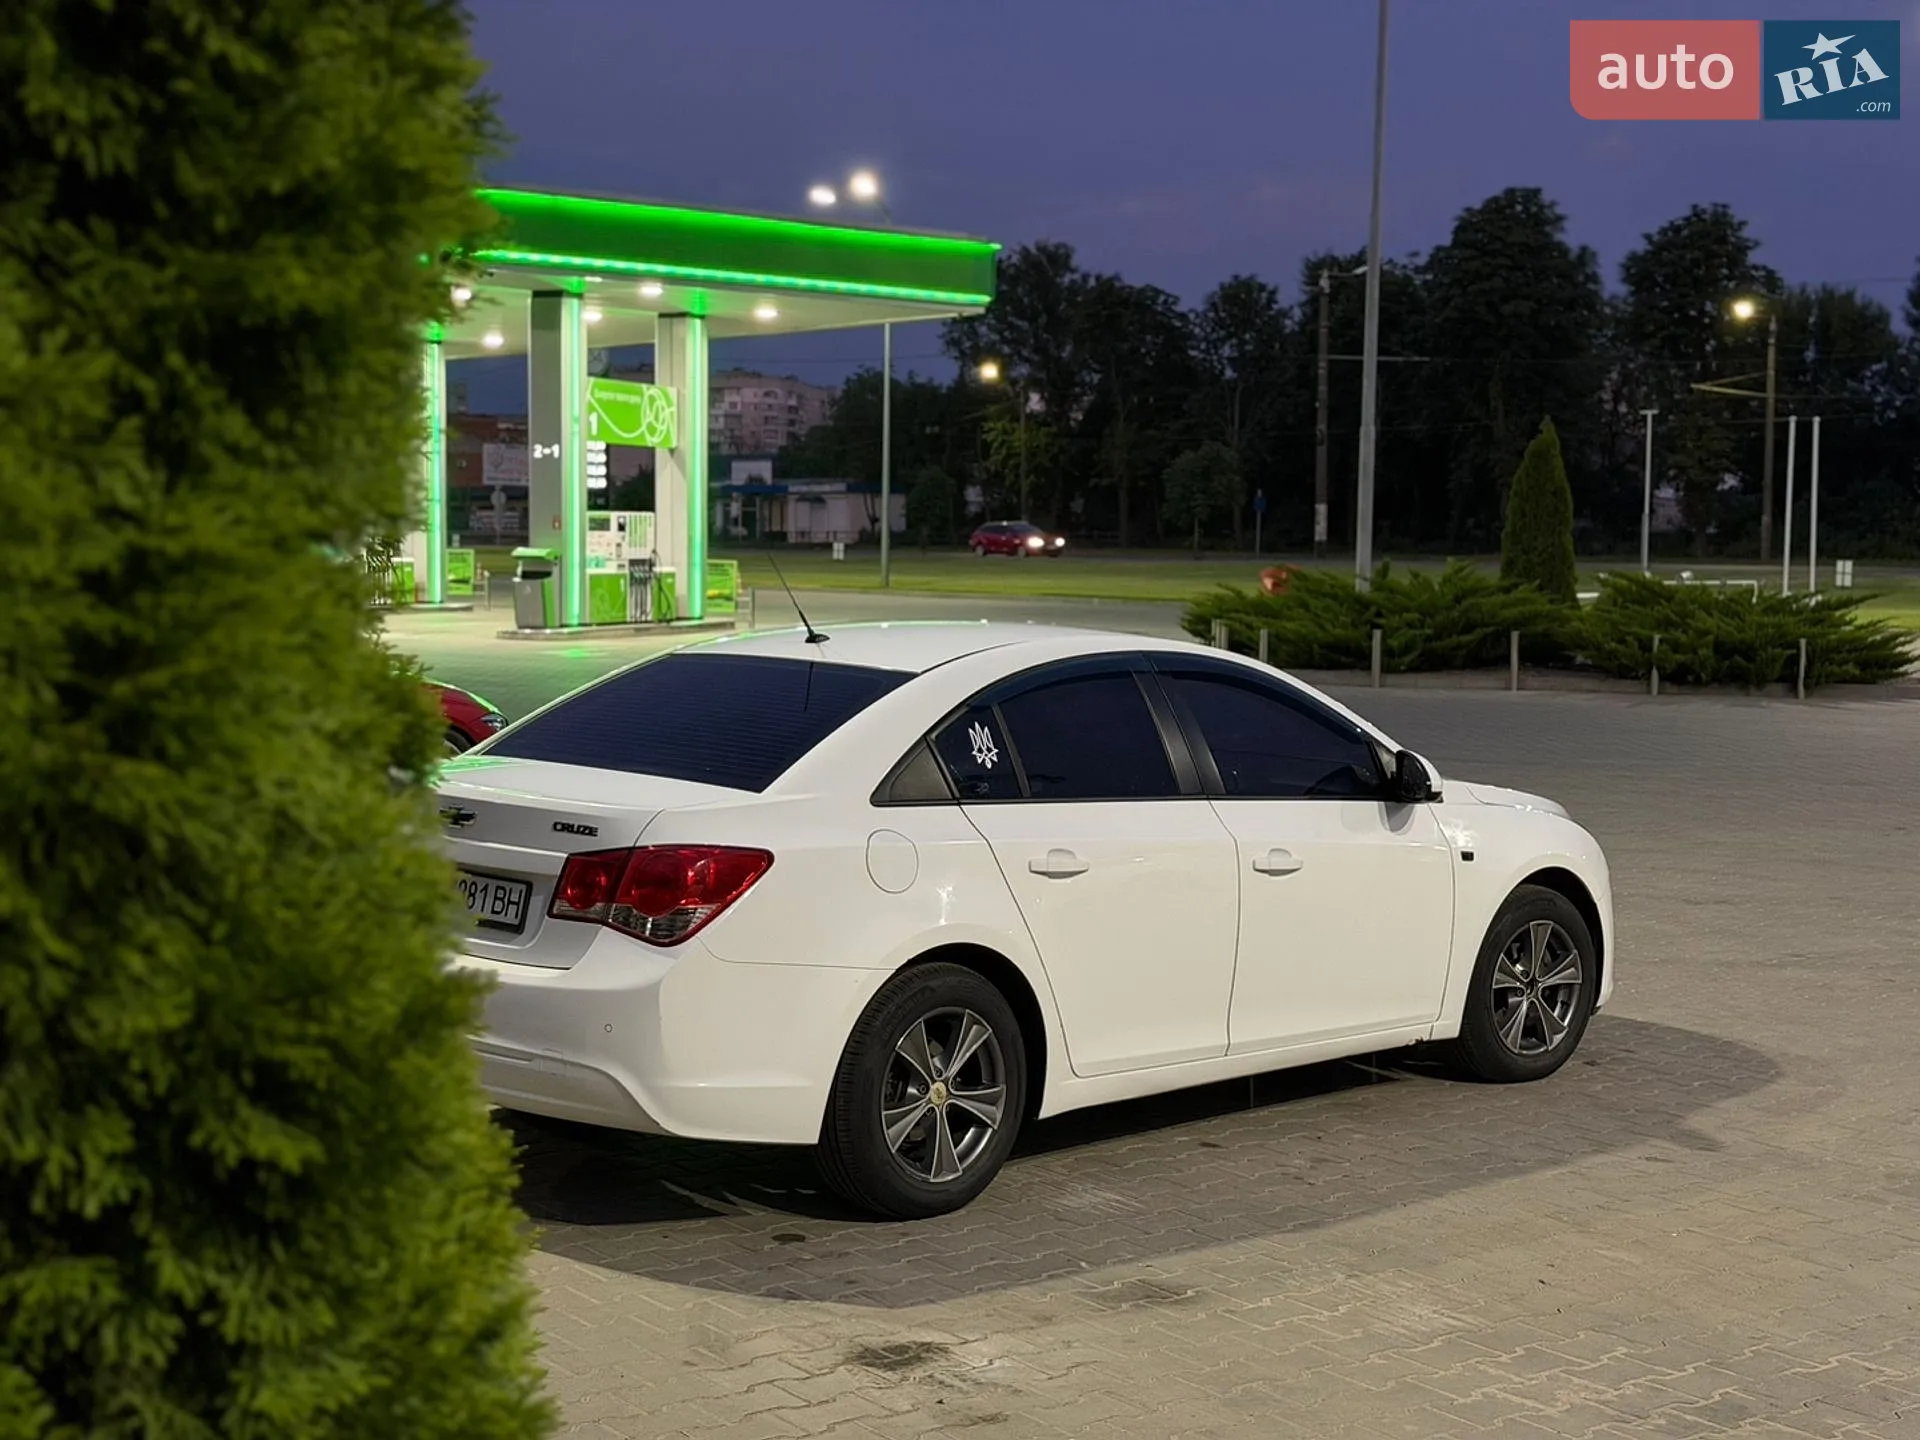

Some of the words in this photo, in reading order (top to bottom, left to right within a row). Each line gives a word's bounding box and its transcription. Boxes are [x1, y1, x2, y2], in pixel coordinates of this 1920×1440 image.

[589, 412, 598, 436] 1
[553, 821, 599, 837] CRUZE
[491, 885, 523, 919] BH
